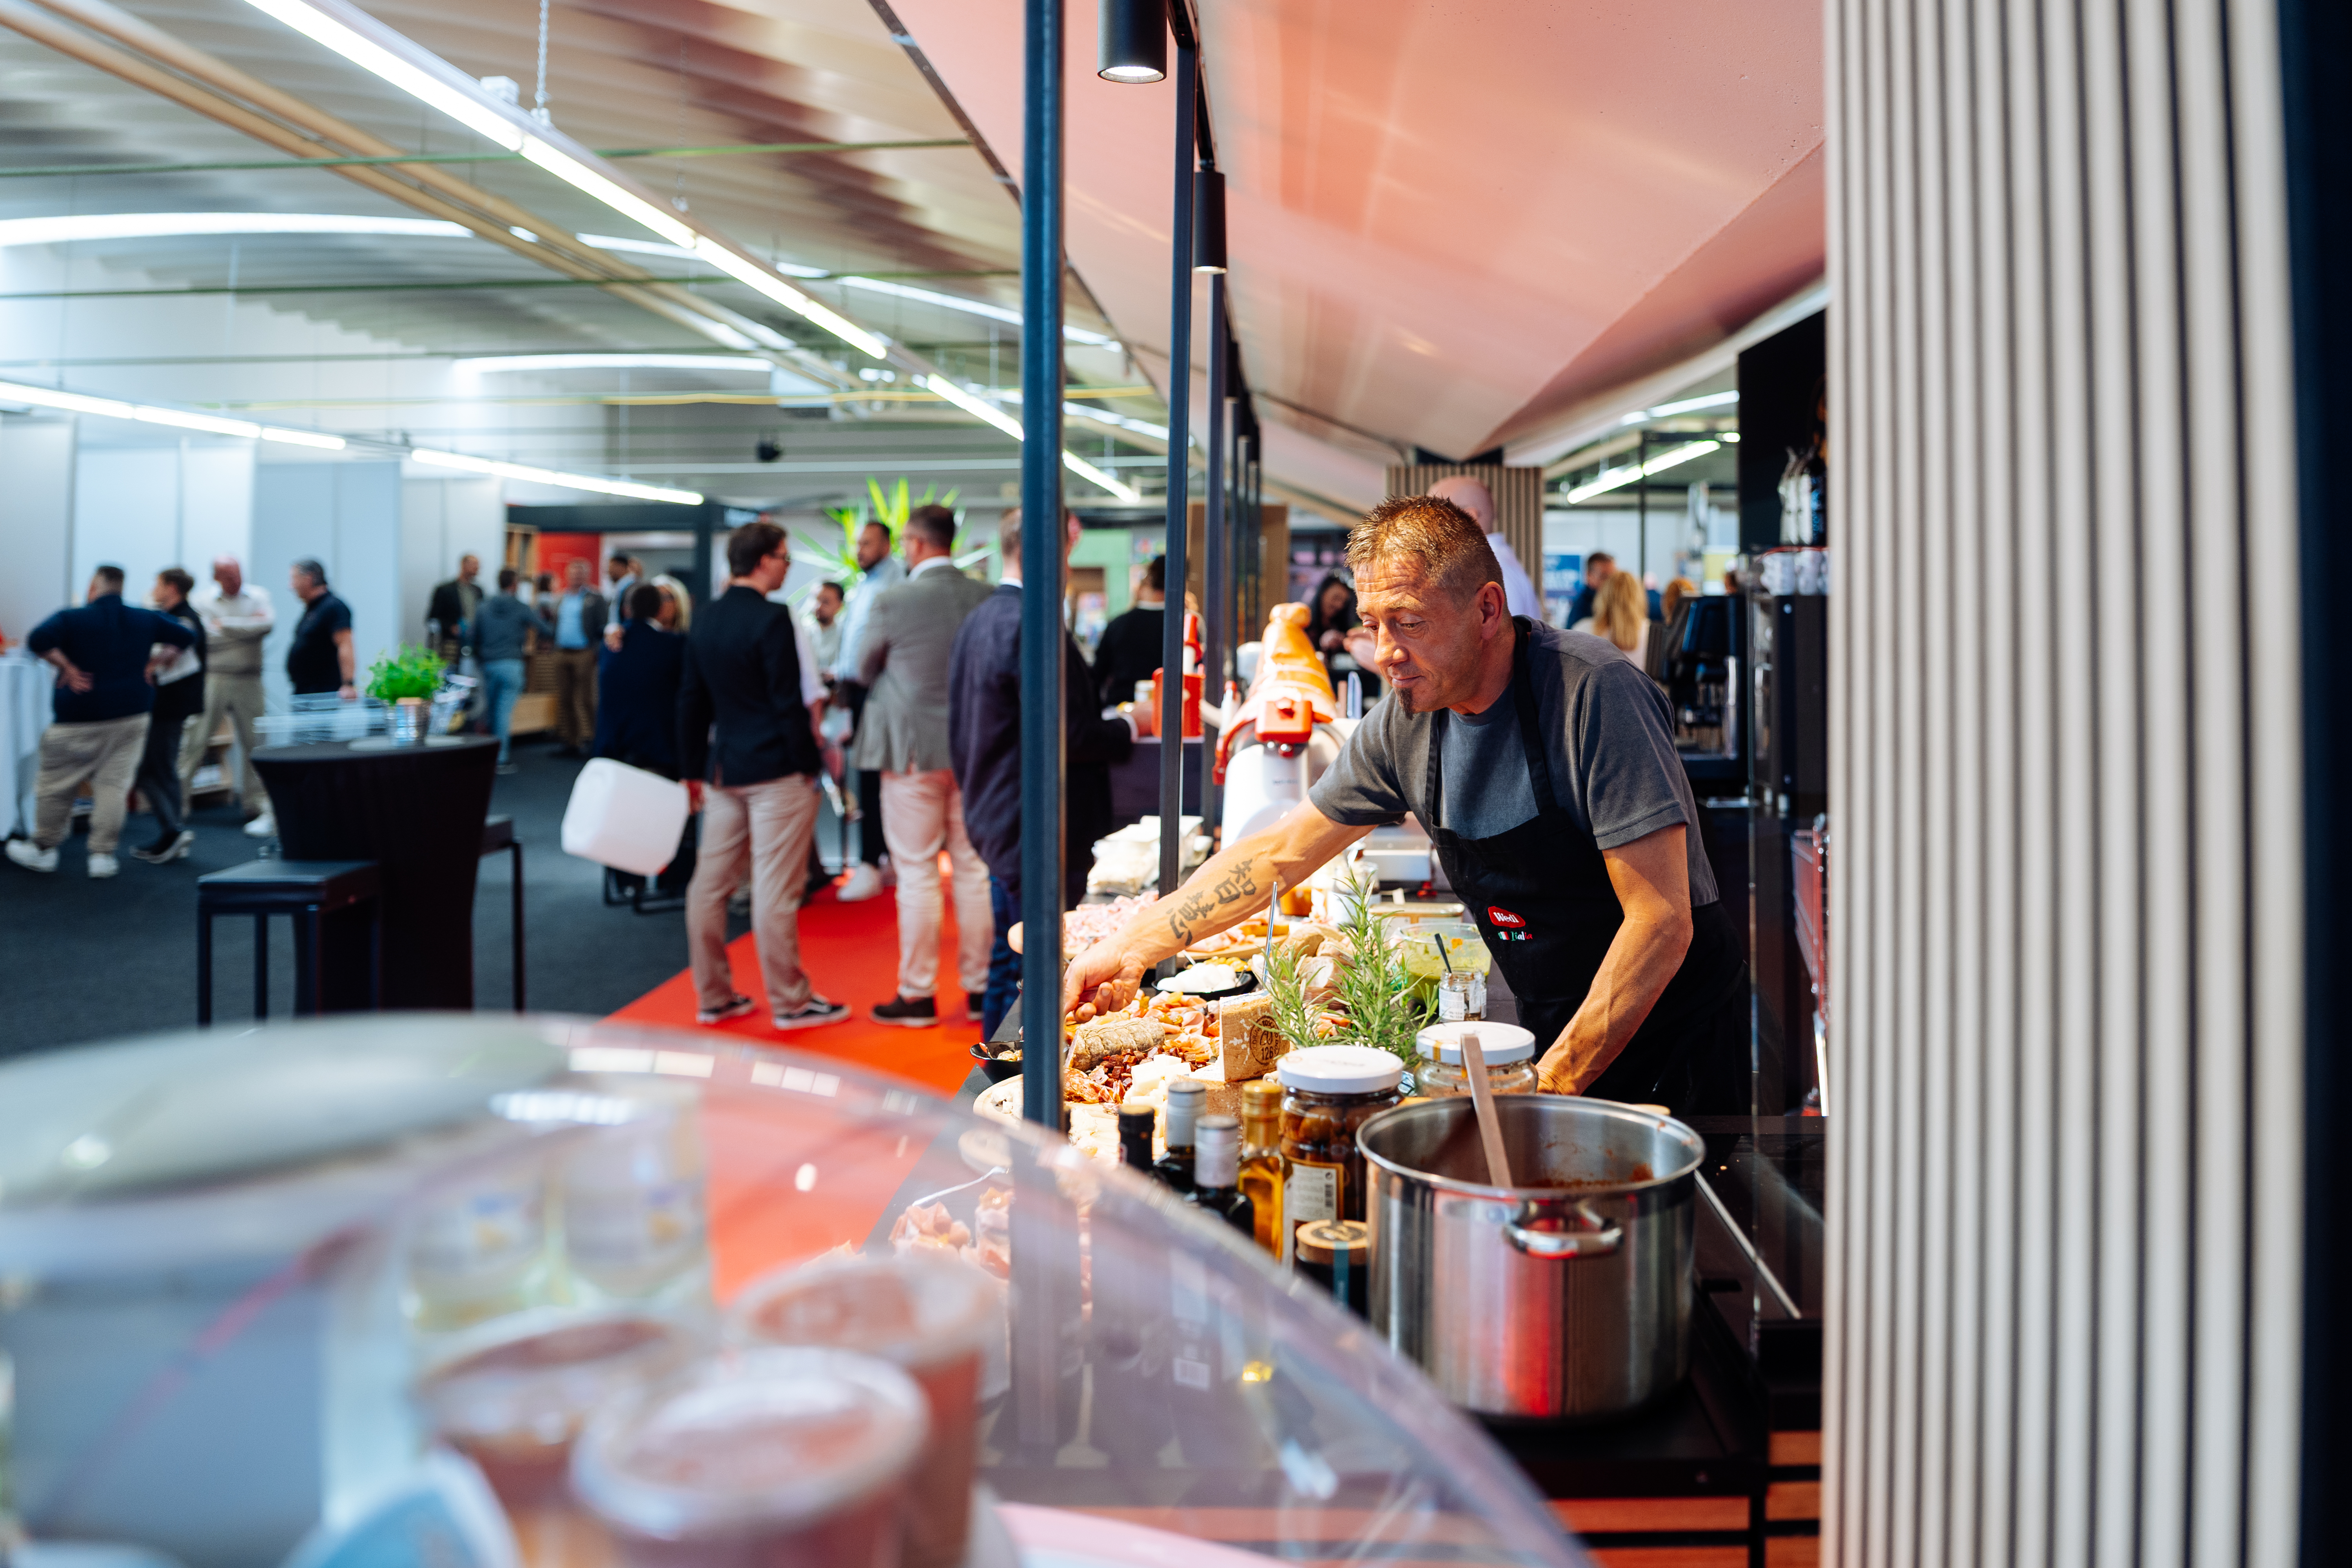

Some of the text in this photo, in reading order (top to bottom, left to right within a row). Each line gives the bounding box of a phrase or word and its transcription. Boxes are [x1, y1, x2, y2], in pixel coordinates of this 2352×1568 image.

[1493, 912, 1519, 923] Wedl
[1510, 931, 1533, 941] Italia
[1261, 1046, 1274, 1060] 126
